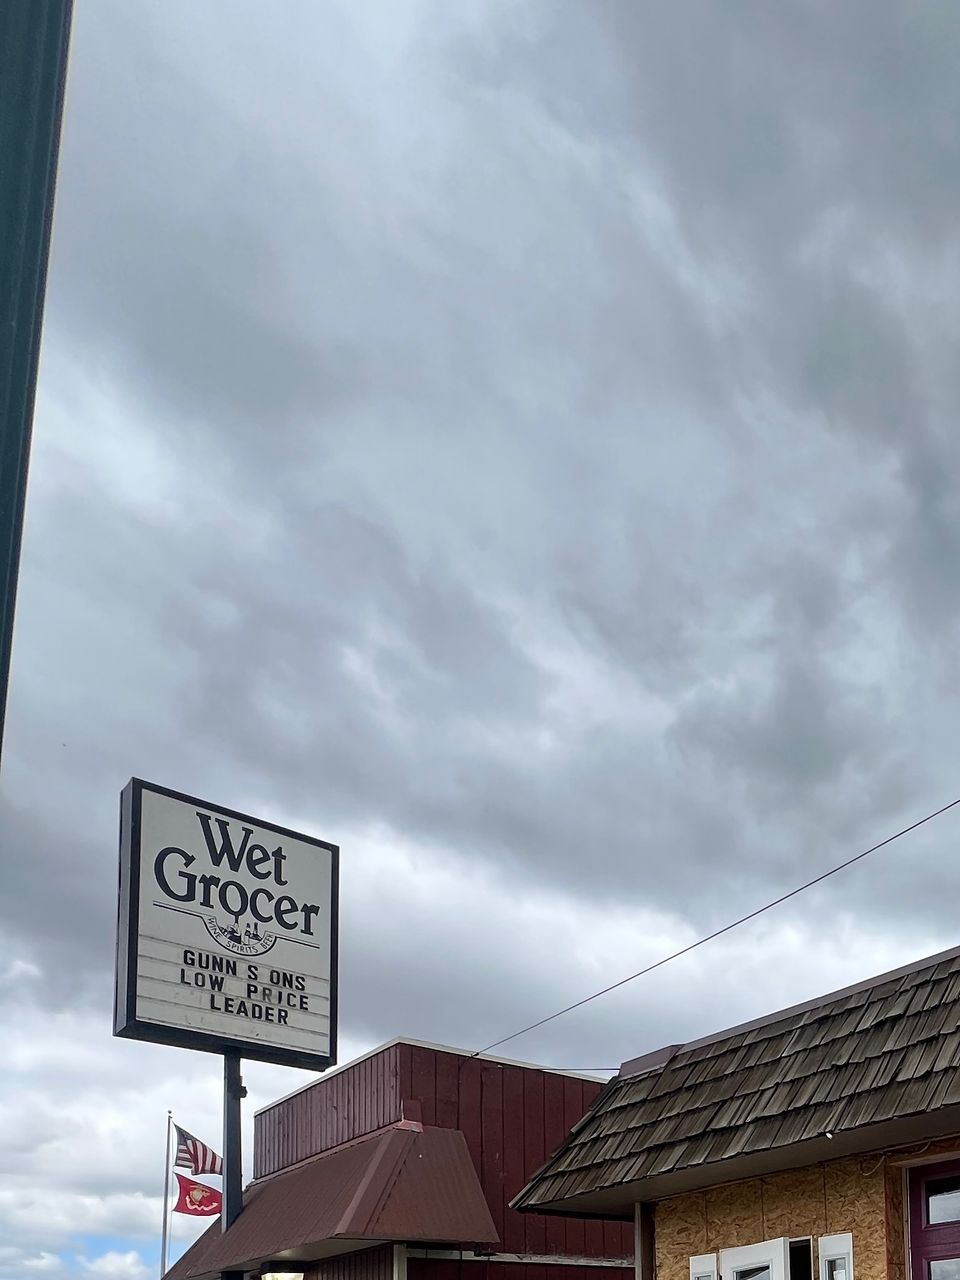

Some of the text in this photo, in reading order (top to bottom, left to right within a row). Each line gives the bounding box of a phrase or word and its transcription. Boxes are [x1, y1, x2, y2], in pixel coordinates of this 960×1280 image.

[196, 811, 288, 886] Wet
[154, 847, 320, 936] Grocer
[207, 917, 274, 954] WINE SPIRITS BEER
[183, 949, 237, 976] GUNN
[180, 968, 309, 1011] LOW PRICE
[210, 994, 289, 1025] LEADER
